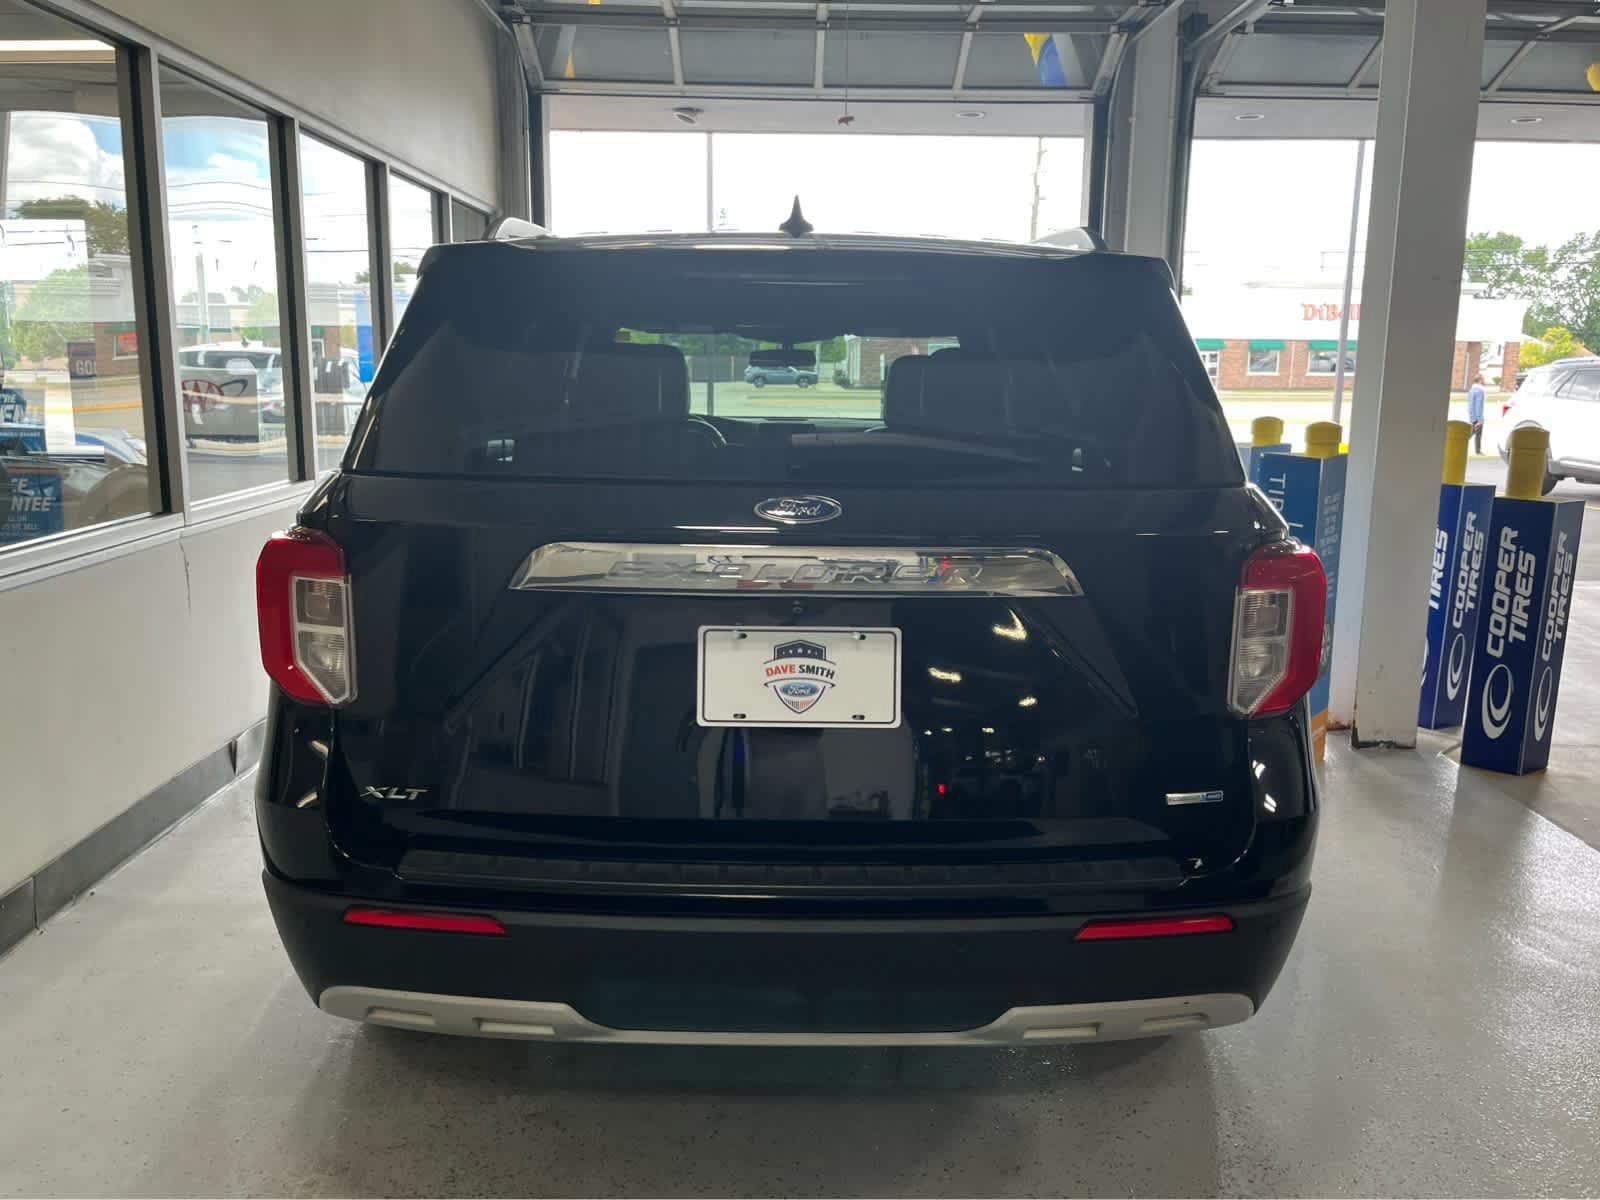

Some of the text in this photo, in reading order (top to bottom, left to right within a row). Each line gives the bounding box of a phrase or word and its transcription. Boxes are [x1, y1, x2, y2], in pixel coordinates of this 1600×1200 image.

[1453, 511, 1477, 629] COOPER
[1464, 530, 1485, 613] TIRES
[1486, 526, 1518, 658] COOPER
[1508, 550, 1536, 643] TIRES
[1541, 531, 1567, 662] COOPER
[1553, 552, 1574, 643] TIRES
[766, 664, 835, 680] DAVE SMITH
[360, 786, 429, 800] XLT
